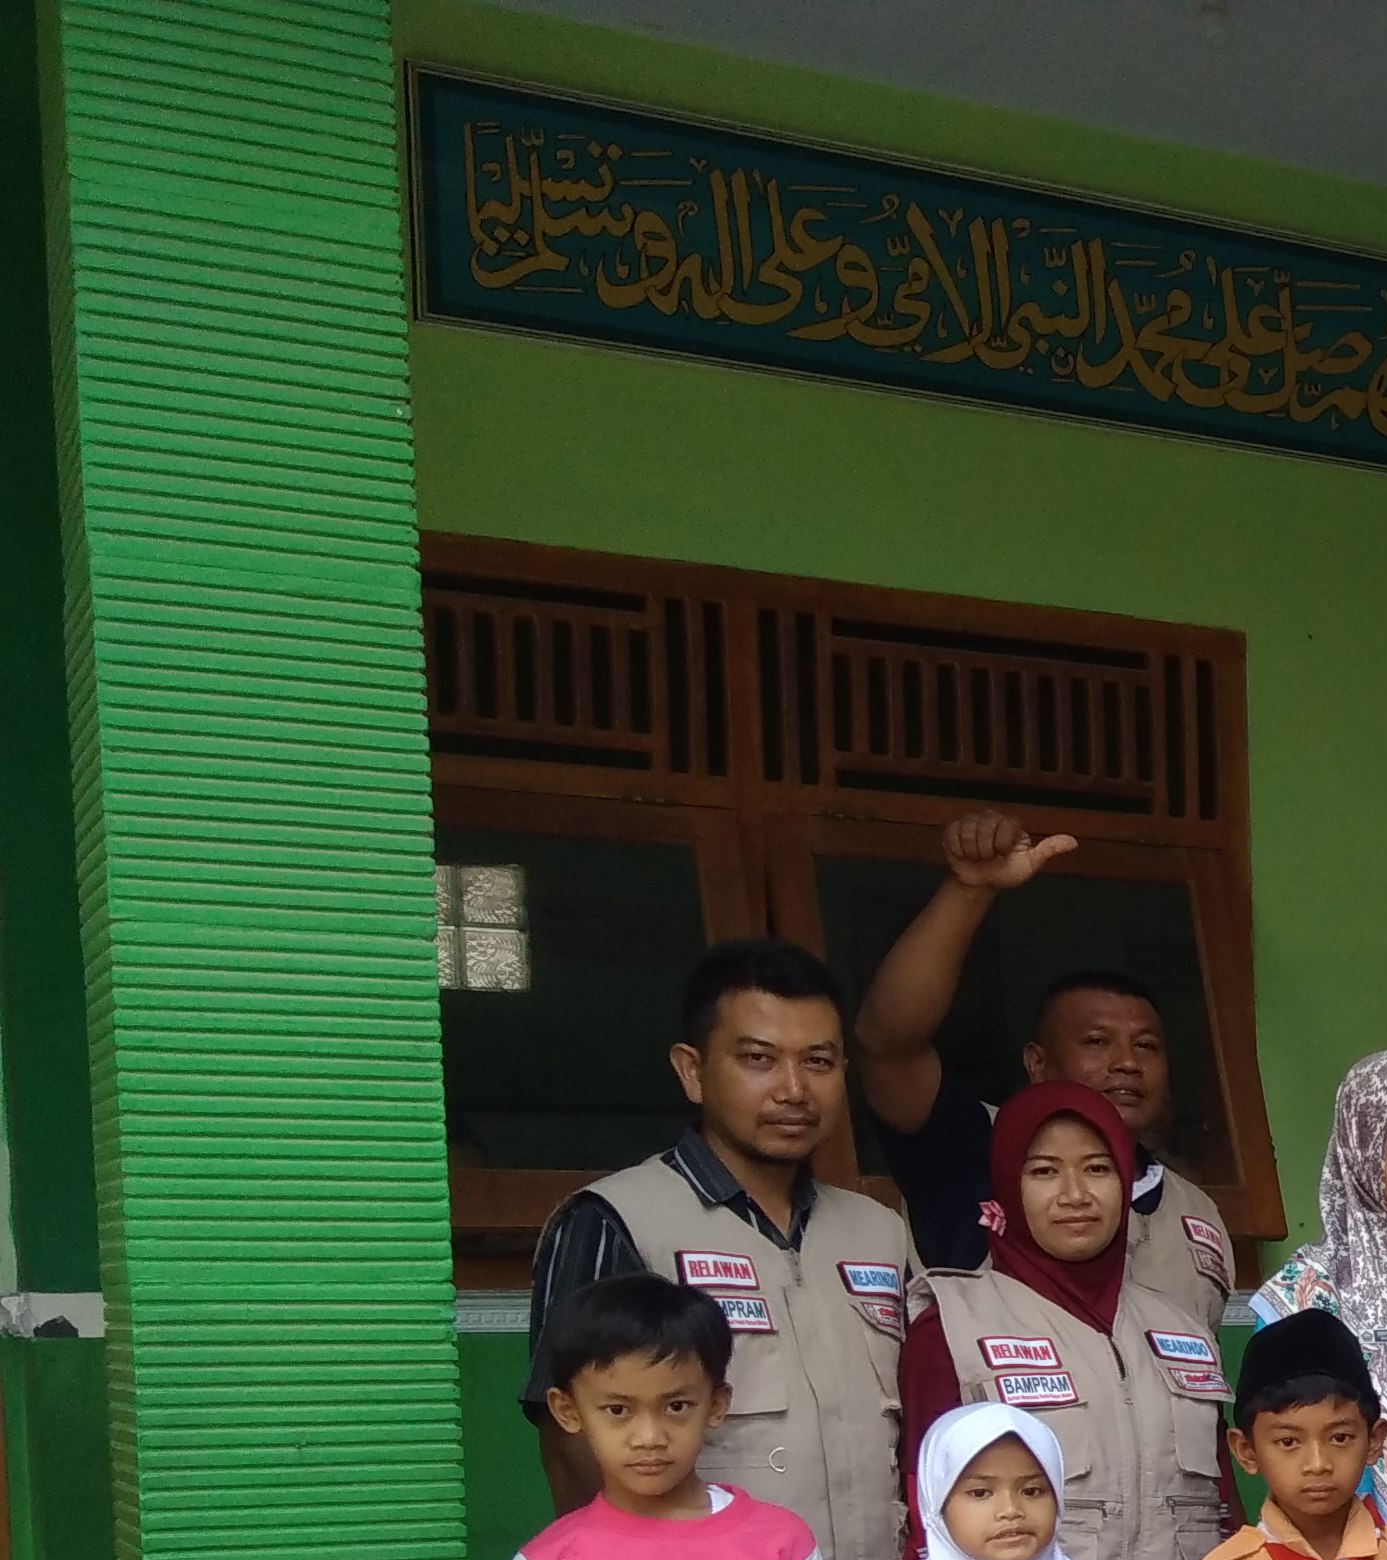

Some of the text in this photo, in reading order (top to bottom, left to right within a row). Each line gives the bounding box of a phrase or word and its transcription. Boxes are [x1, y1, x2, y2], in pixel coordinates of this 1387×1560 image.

[688, 1260, 752, 1280] RELAWAN
[990, 1344, 1052, 1361] RELAWAN
[1157, 1337, 1209, 1358] MEARINDO
[1003, 1376, 1070, 1394] BAMPRAM
